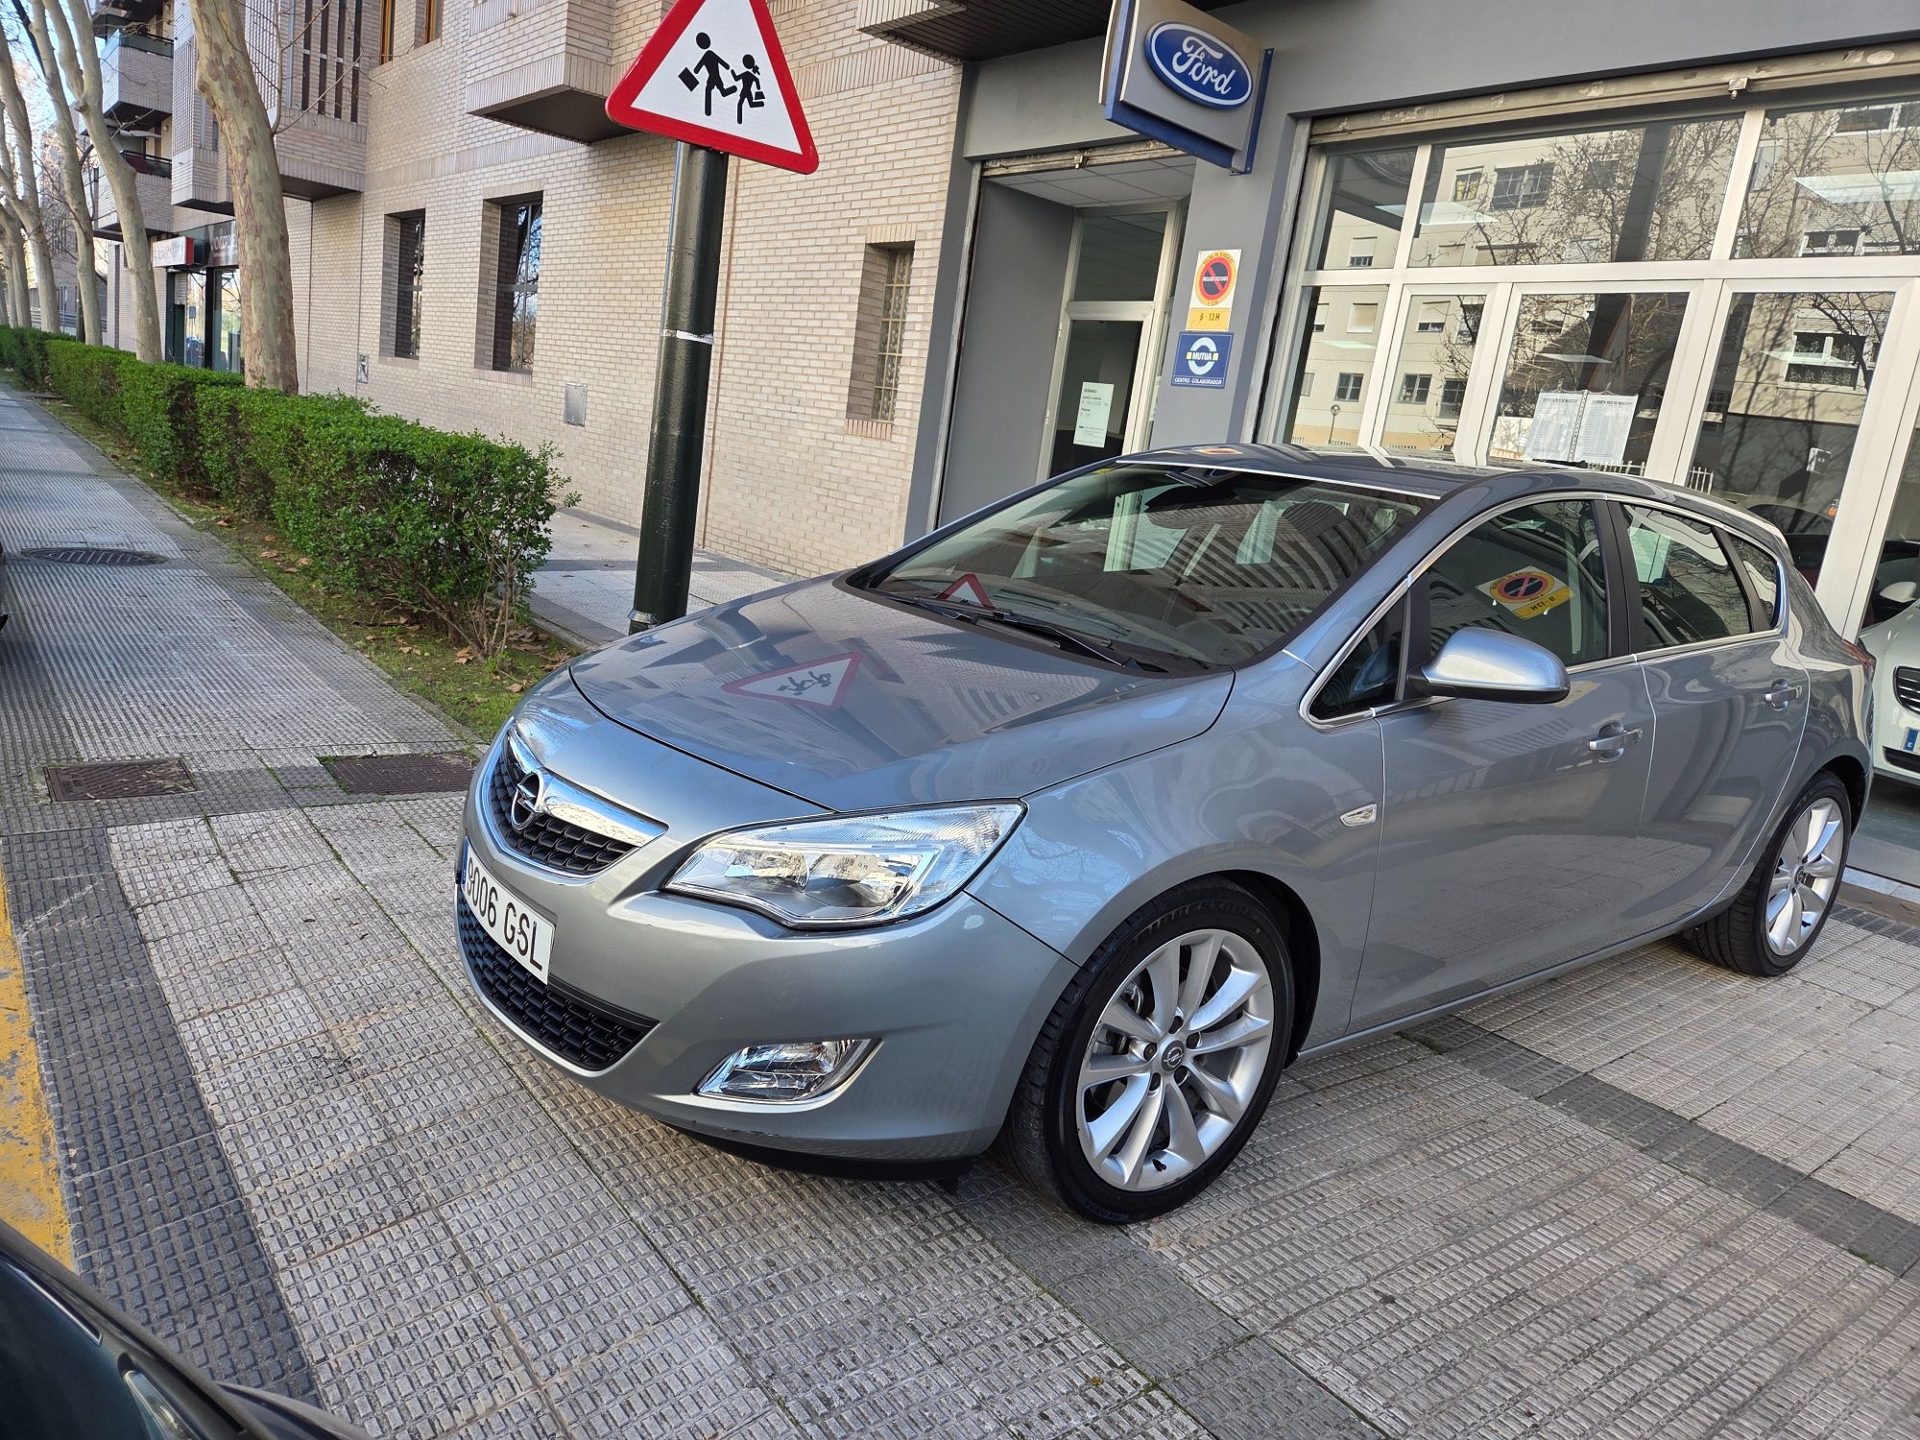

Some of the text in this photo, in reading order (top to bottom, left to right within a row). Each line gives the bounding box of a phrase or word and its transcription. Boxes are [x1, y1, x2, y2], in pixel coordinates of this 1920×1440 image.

[1171, 35, 1237, 95] Ford
[1192, 352, 1213, 360] MUTUA
[1174, 376, 1223, 385] CENTRO COLABORADOR
[466, 857, 543, 972] 9006 GSL
